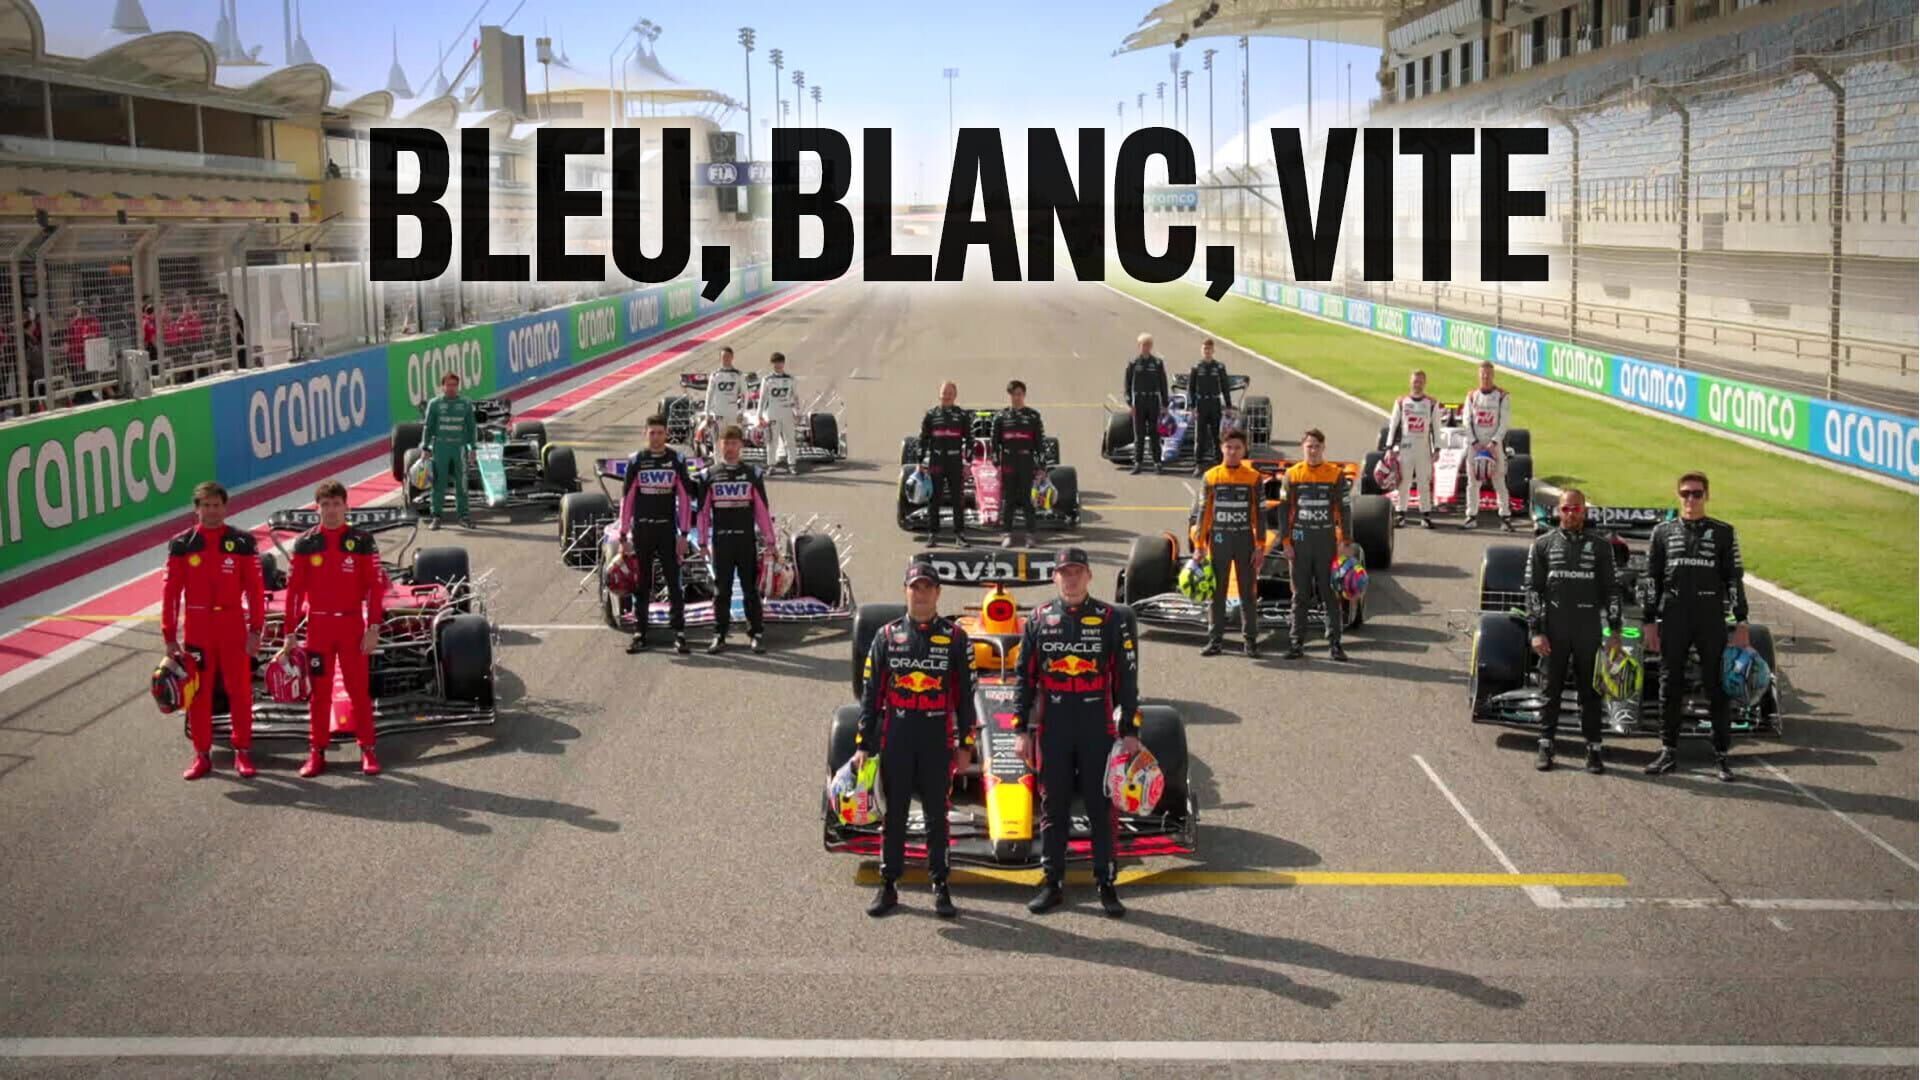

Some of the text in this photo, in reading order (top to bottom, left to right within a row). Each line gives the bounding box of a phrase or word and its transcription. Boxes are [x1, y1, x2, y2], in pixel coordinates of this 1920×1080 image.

[708, 166, 736, 181] FIA
[508, 319, 561, 373] aramco
[578, 306, 616, 350] aramco
[1410, 313, 1442, 345] aramco
[1450, 323, 1486, 355] aramco
[407, 340, 482, 407] aramco
[1495, 334, 1539, 370] aramco
[1551, 340, 1604, 389] aramco
[1620, 361, 1687, 412] aramco
[249, 367, 367, 459] aramco
[1708, 383, 1796, 441] aramco
[1824, 408, 1919, 477] aramc
[0, 414, 177, 546] ramco
[639, 471, 674, 484] BWT
[715, 484, 748, 497] BWT
[889, 657, 949, 671] ORACLE
[1042, 642, 1103, 653] ORACLE
